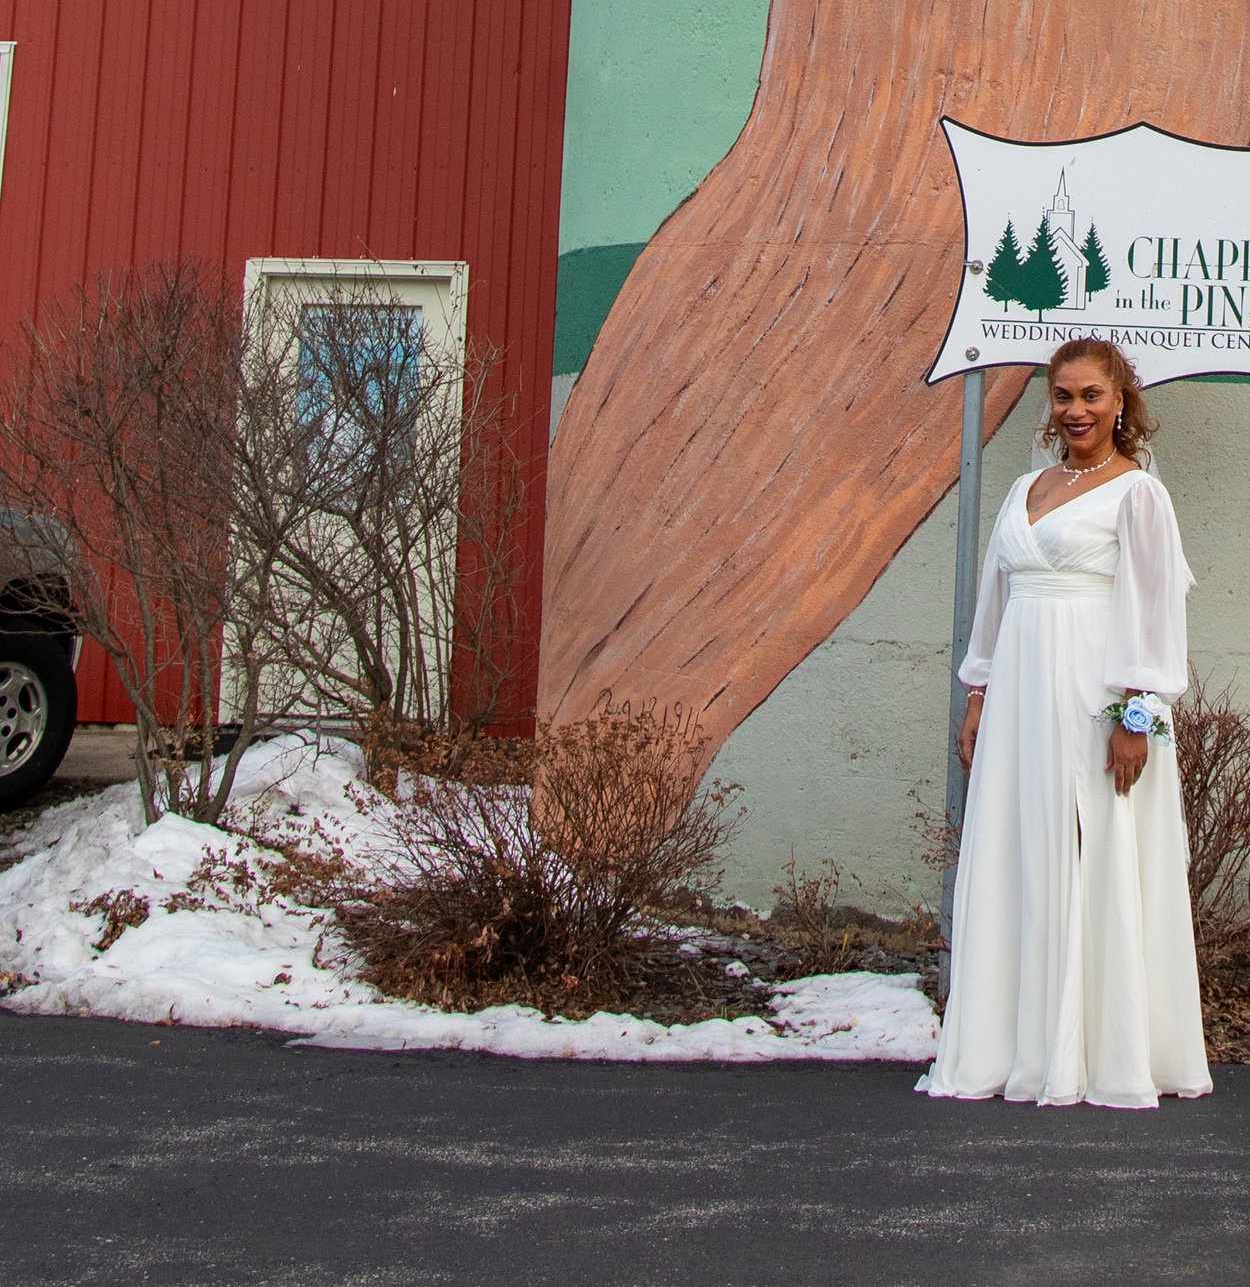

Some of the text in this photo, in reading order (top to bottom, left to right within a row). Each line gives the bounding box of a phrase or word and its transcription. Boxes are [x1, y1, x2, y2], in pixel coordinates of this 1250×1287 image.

[1115, 290, 1133, 309] in
[1140, 283, 1171, 310] the
[981, 323, 1083, 342] WEDDING
[1110, 329, 1207, 350] BANQUET
